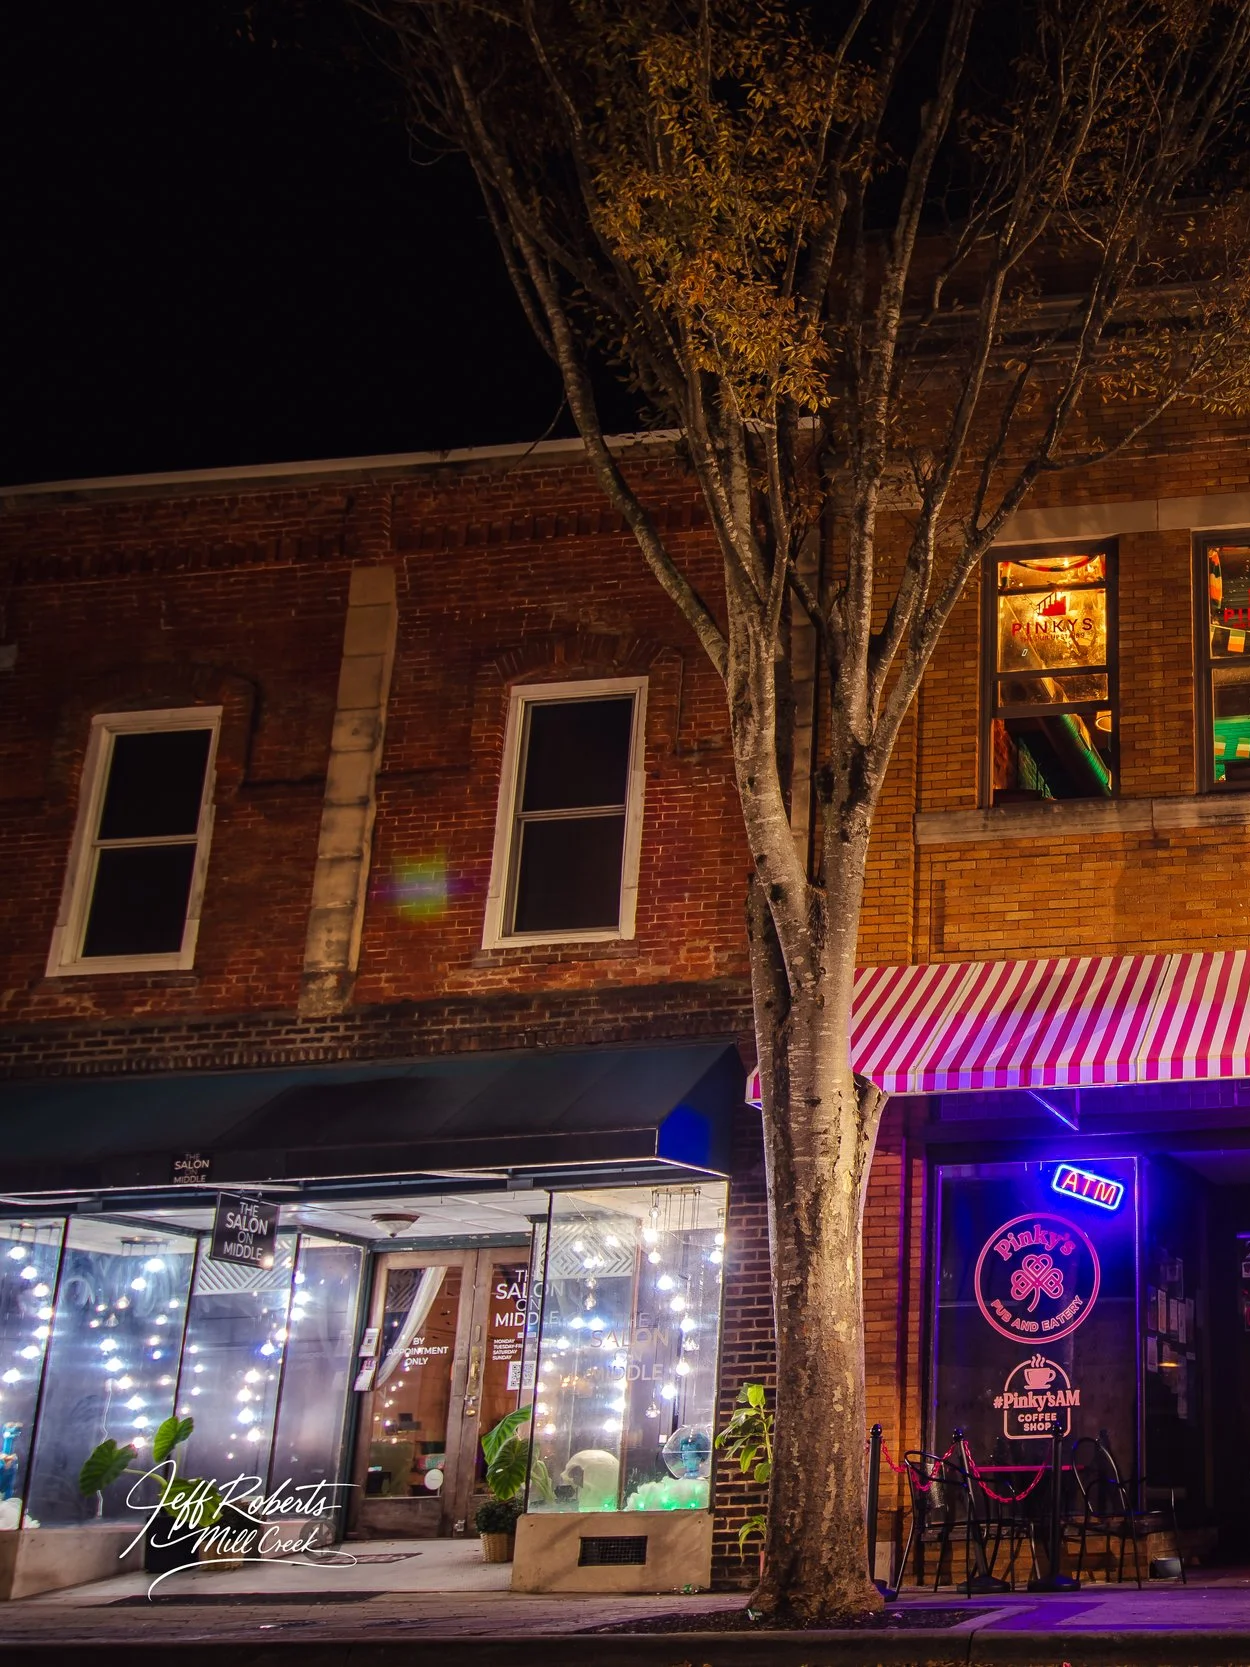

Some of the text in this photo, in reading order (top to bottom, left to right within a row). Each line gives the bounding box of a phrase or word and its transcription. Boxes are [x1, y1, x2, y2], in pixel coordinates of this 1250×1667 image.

[1011, 617, 1093, 637] PINKYS
[174, 1159, 210, 1170] SALON
[185, 1153, 201, 1161] THE
[173, 1175, 207, 1184] MIDDLE
[1061, 1171, 1117, 1205] ATM
[240, 1201, 260, 1218] THE
[225, 1212, 269, 1236] SALON
[237, 1231, 254, 1245] ON
[993, 1223, 1077, 1261] Pinky's
[223, 1241, 263, 1261] MIDDLE
[495, 1281, 565, 1300] SALON
[516, 1298, 542, 1312] ON
[990, 1294, 1084, 1333] PUB AND EATERY
[413, 1337, 426, 1346] BY
[590, 1328, 669, 1348] SALON
[405, 1357, 429, 1367] ONLY
[993, 1389, 1081, 1413] #Pinky'sAM
[1017, 1412, 1058, 1423] COFFEE
[1023, 1422, 1053, 1432] SHOP
